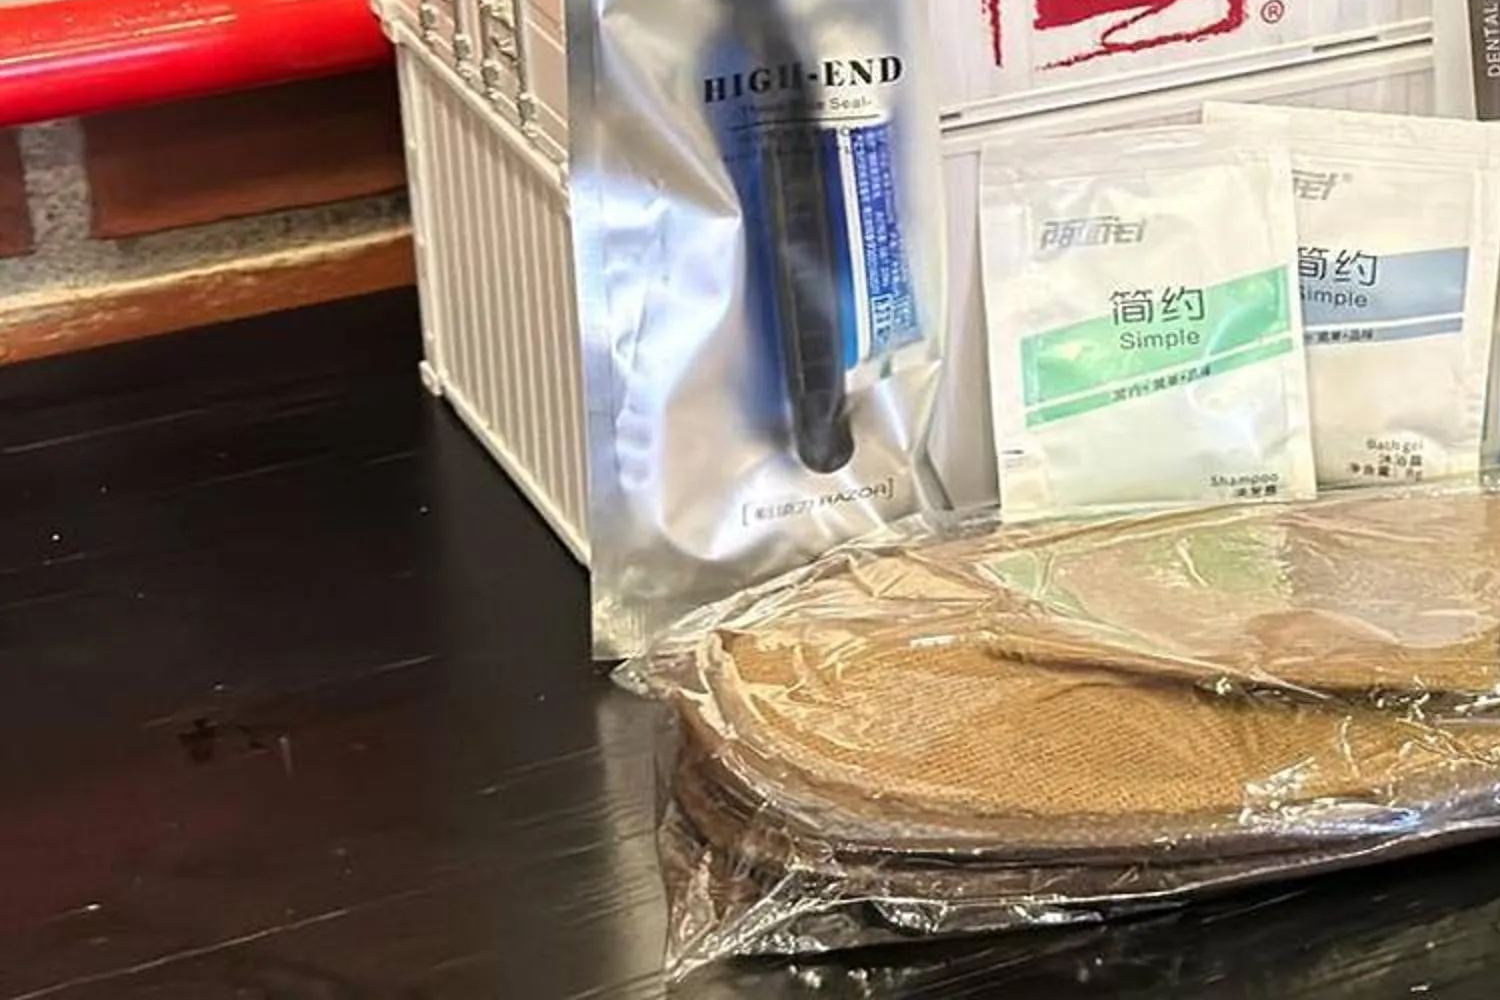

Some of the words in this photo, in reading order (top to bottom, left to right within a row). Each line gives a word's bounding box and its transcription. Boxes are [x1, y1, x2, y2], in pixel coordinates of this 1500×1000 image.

[704, 55, 903, 104] HIGH-END
[1298, 247, 1377, 287] 简约
[1109, 286, 1205, 326] 简约
[1119, 329, 1201, 351] Simple
